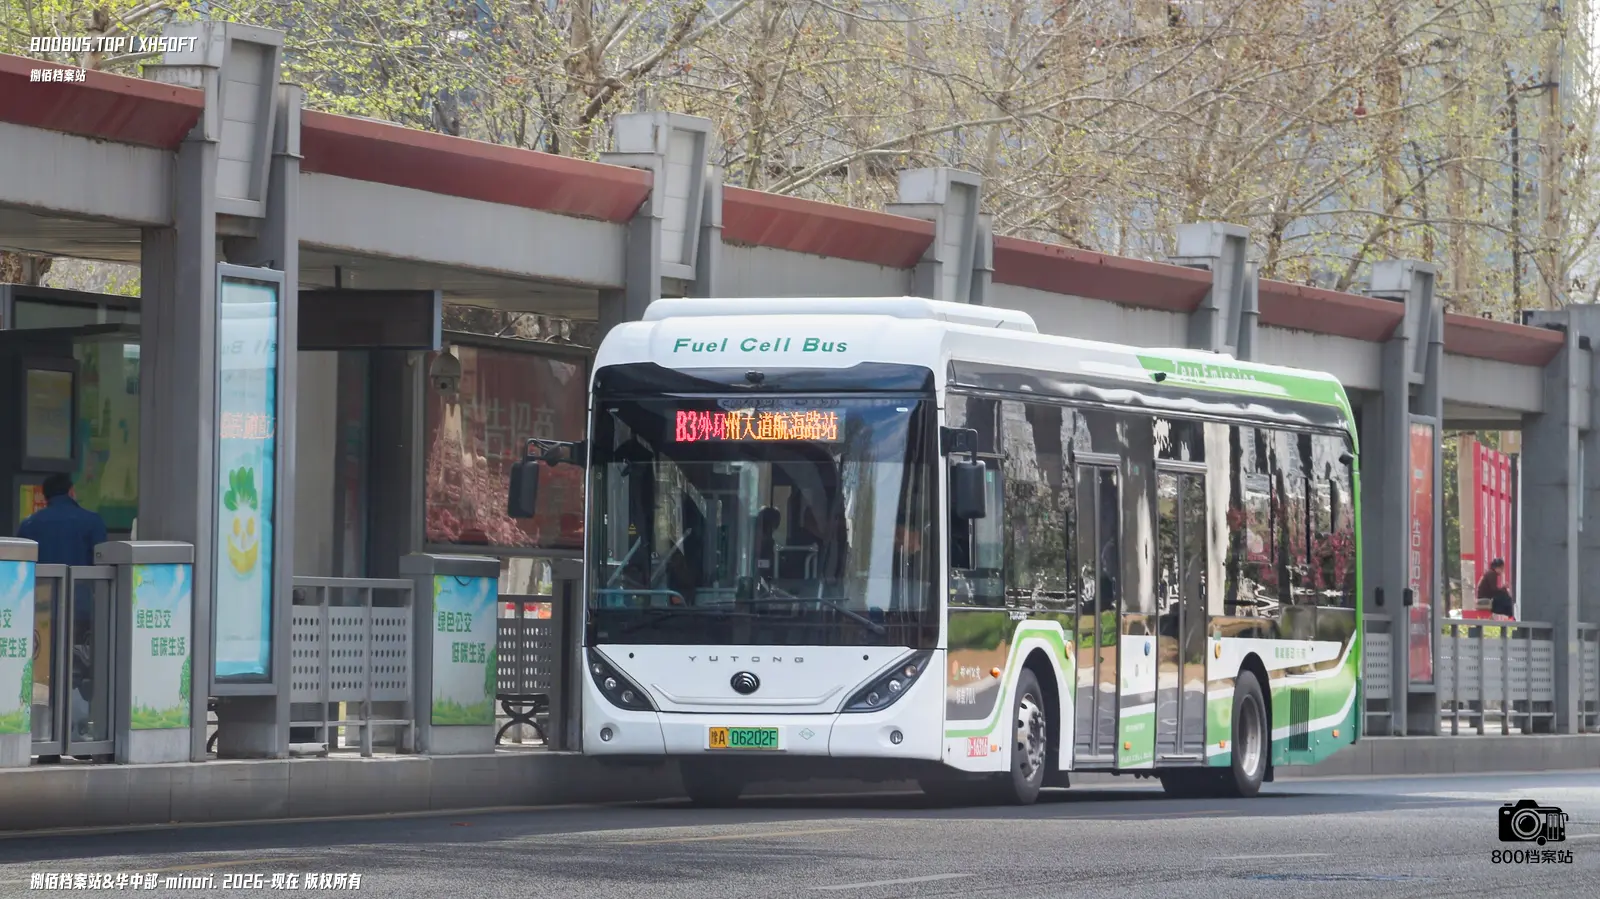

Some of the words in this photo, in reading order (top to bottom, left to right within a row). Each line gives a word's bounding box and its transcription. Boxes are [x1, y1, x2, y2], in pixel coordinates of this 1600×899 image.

[673, 338, 729, 353] Fuel
[740, 337, 791, 353] Cell
[802, 337, 848, 353] Bus
[0, 608, 12, 629] 交
[136, 608, 172, 629] 绿色公交
[437, 611, 473, 633] 绿色公交
[151, 636, 186, 657] 低碳生活
[451, 641, 486, 664] 低碳生活
[688, 655, 805, 664] YUTONG
[731, 729, 777, 746] 06202F
